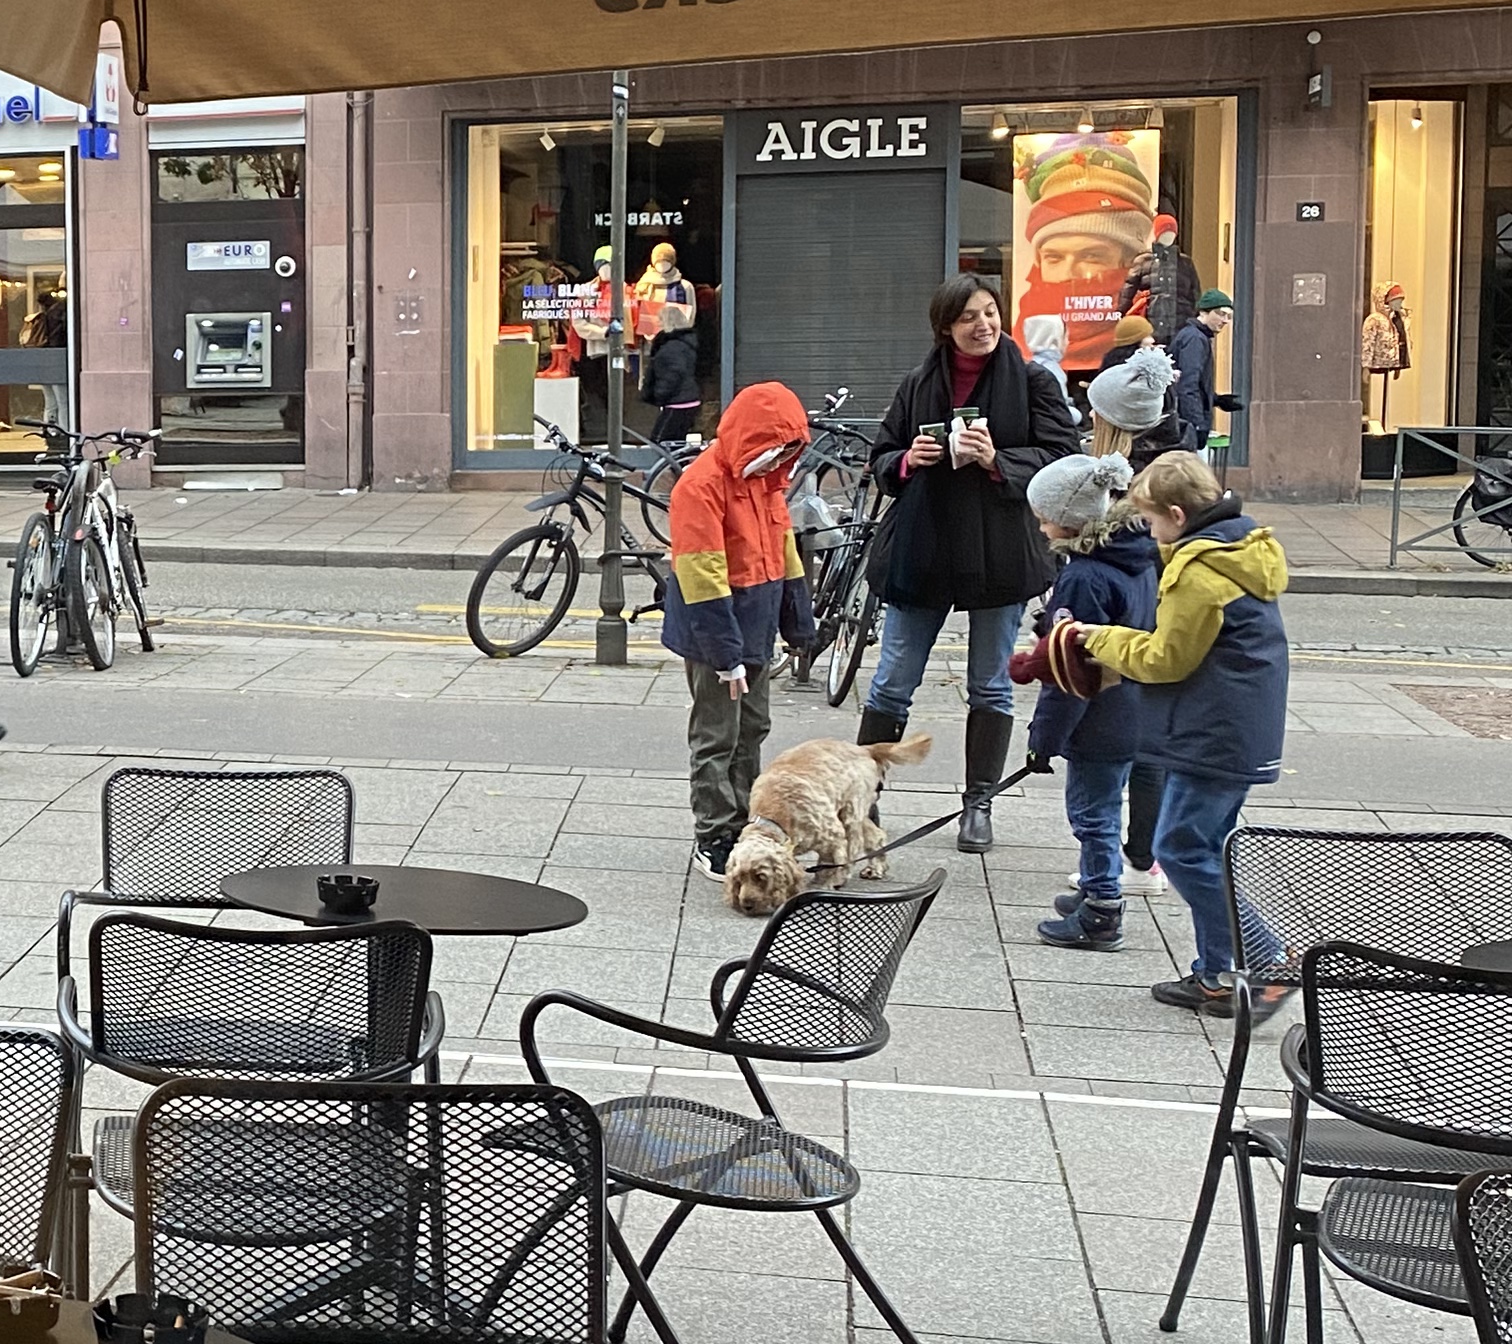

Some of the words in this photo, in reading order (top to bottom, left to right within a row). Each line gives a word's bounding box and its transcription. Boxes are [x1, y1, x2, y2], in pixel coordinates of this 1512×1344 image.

[755, 117, 927, 162] AIGLE
[522, 300, 534, 309] LA
[583, 299, 594, 308] DE
[1064, 296, 1113, 310] L'HIVER
[572, 309, 583, 318] EN
[1071, 311, 1104, 322] GRAND
[1105, 311, 1122, 321] AIR
